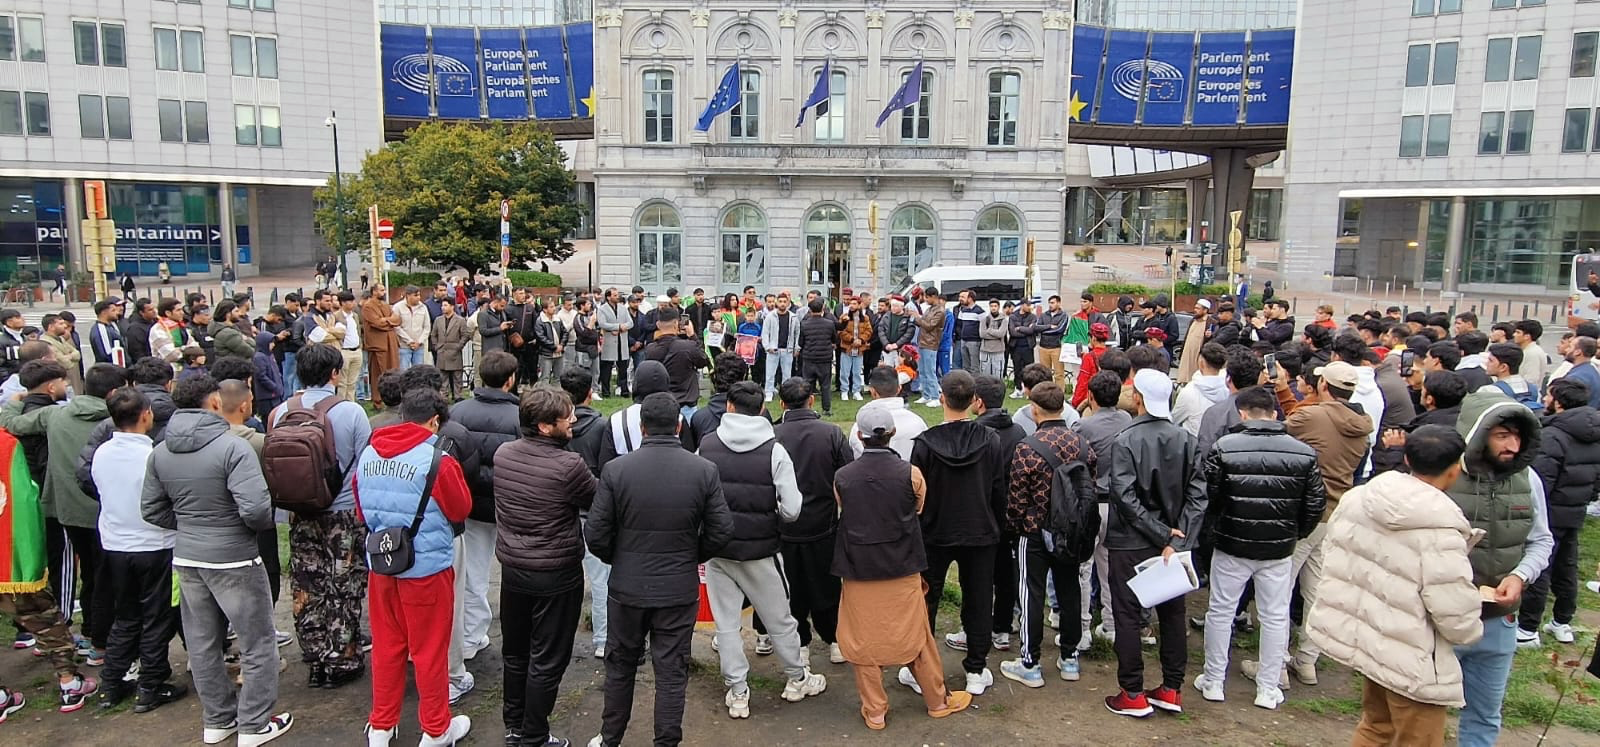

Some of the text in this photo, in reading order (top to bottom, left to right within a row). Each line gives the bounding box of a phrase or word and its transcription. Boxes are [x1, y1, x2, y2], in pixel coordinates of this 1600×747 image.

[484, 48, 539, 60] European
[1200, 51, 1271, 63] Parlement
[485, 60, 548, 71] Parliament
[1199, 64, 1264, 76] européen
[486, 74, 561, 87] Europäisches
[1198, 80, 1262, 92] Europees
[487, 87, 548, 98] Parlament
[1197, 92, 1268, 103] Parlement
[37, 226, 202, 241] parentarium
[363, 459, 418, 482] HOODRICH
